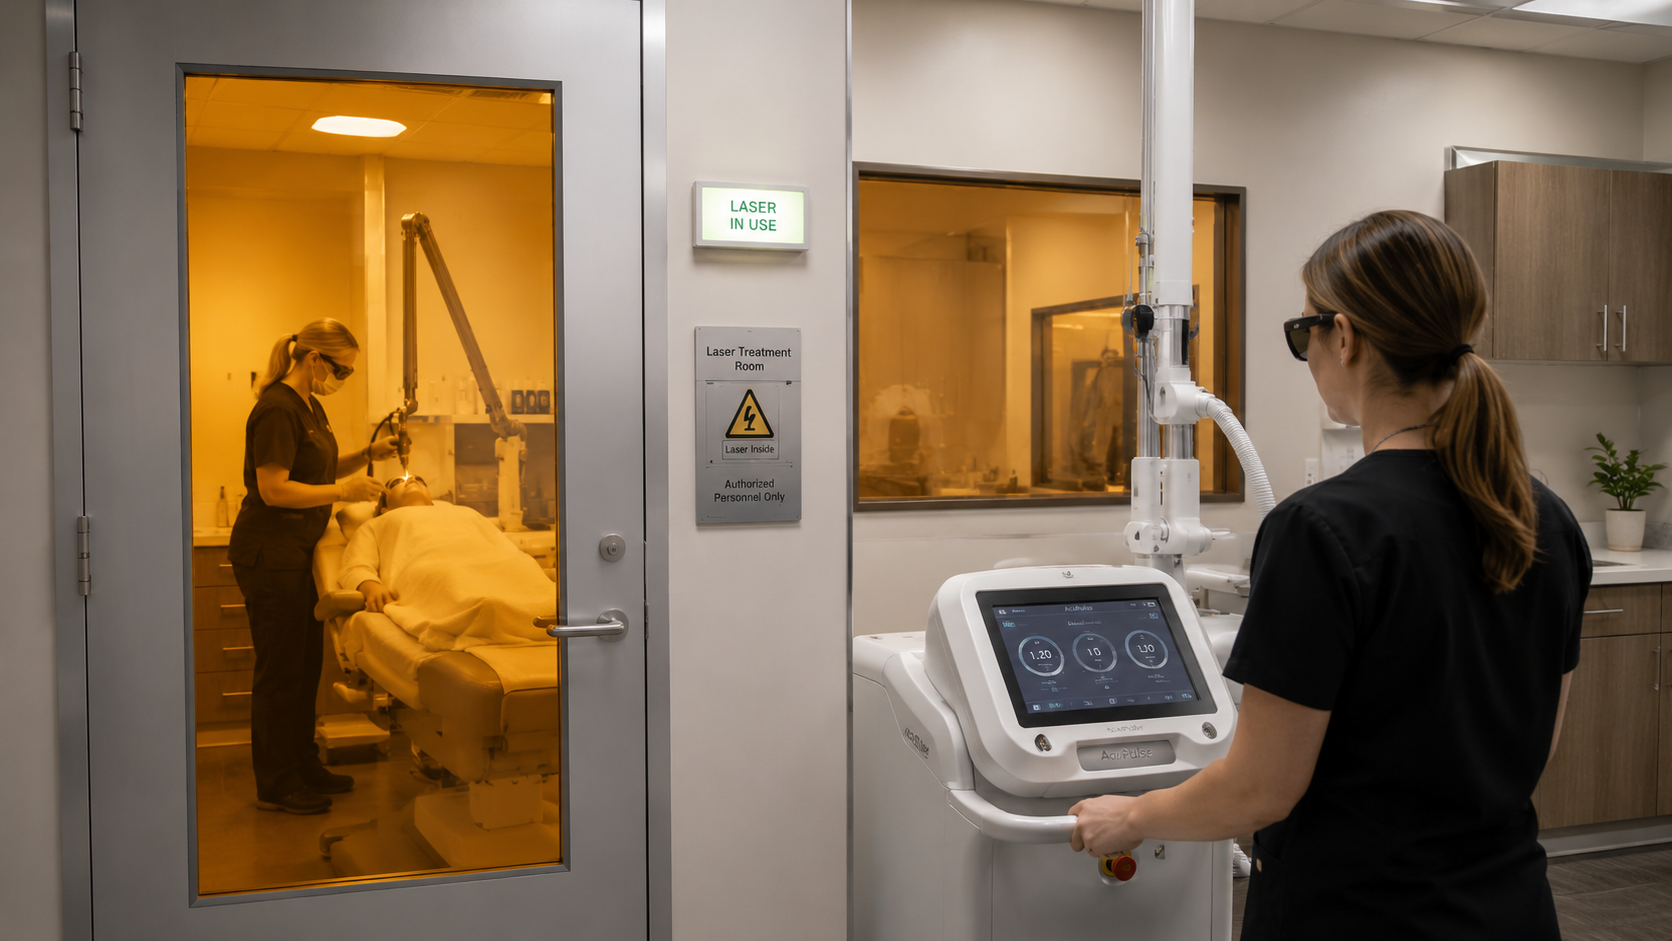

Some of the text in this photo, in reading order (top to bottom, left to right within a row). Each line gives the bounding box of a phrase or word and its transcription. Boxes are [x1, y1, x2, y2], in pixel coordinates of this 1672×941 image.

[731, 200, 777, 213] LASER
[730, 217, 777, 231] IN USE
[706, 346, 792, 358] Laser Treatment
[734, 361, 765, 371] Room
[725, 444, 775, 454] Laser Inside
[724, 478, 775, 489] Authorized
[714, 491, 785, 503] Personnel Only
